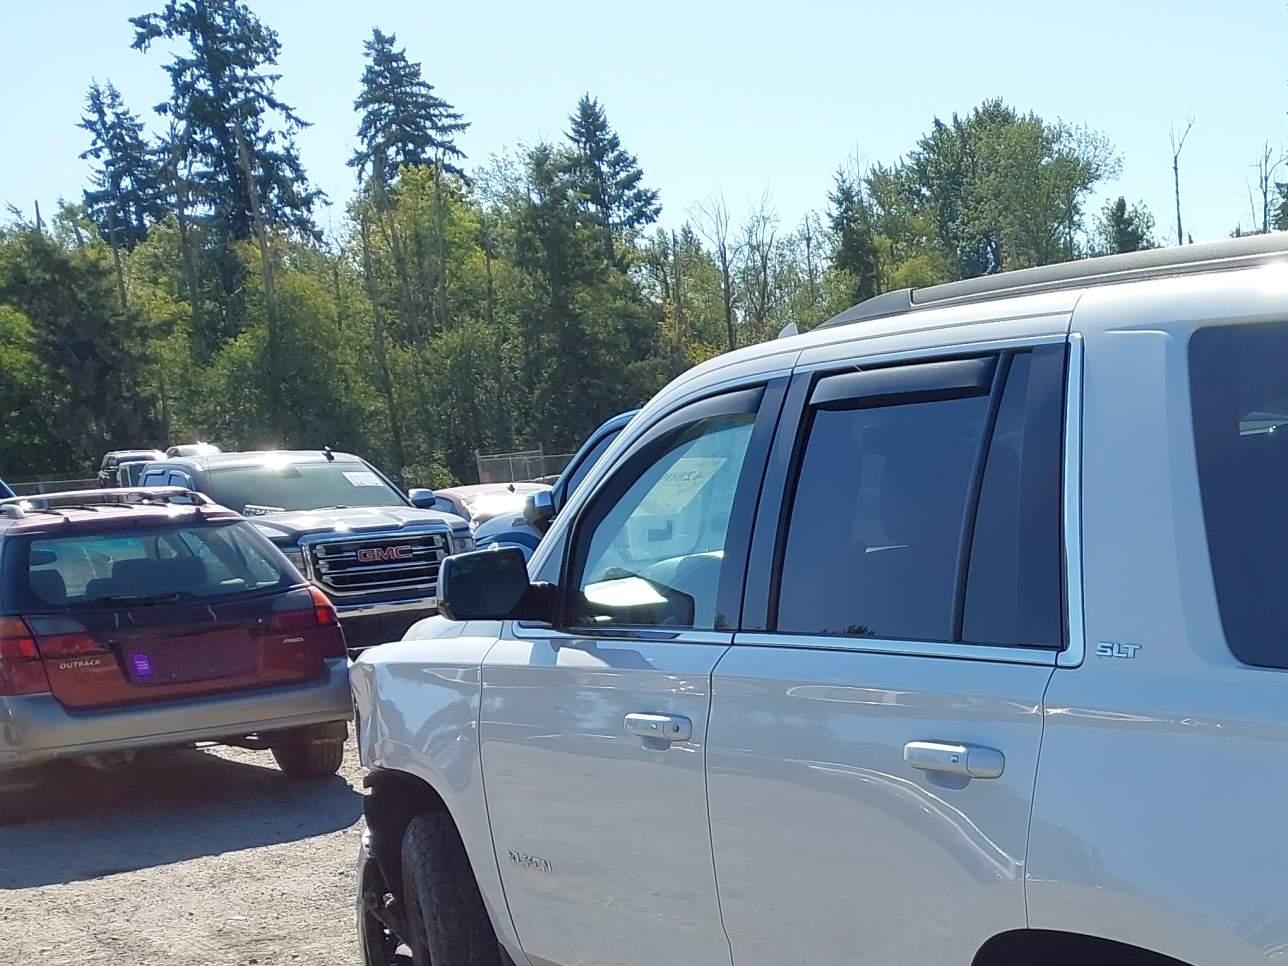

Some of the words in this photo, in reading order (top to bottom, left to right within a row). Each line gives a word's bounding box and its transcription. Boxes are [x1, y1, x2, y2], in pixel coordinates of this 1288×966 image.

[357, 545, 412, 562] GMC
[1096, 641, 1142, 658] SLT
[59, 659, 101, 670] OUTBACK
